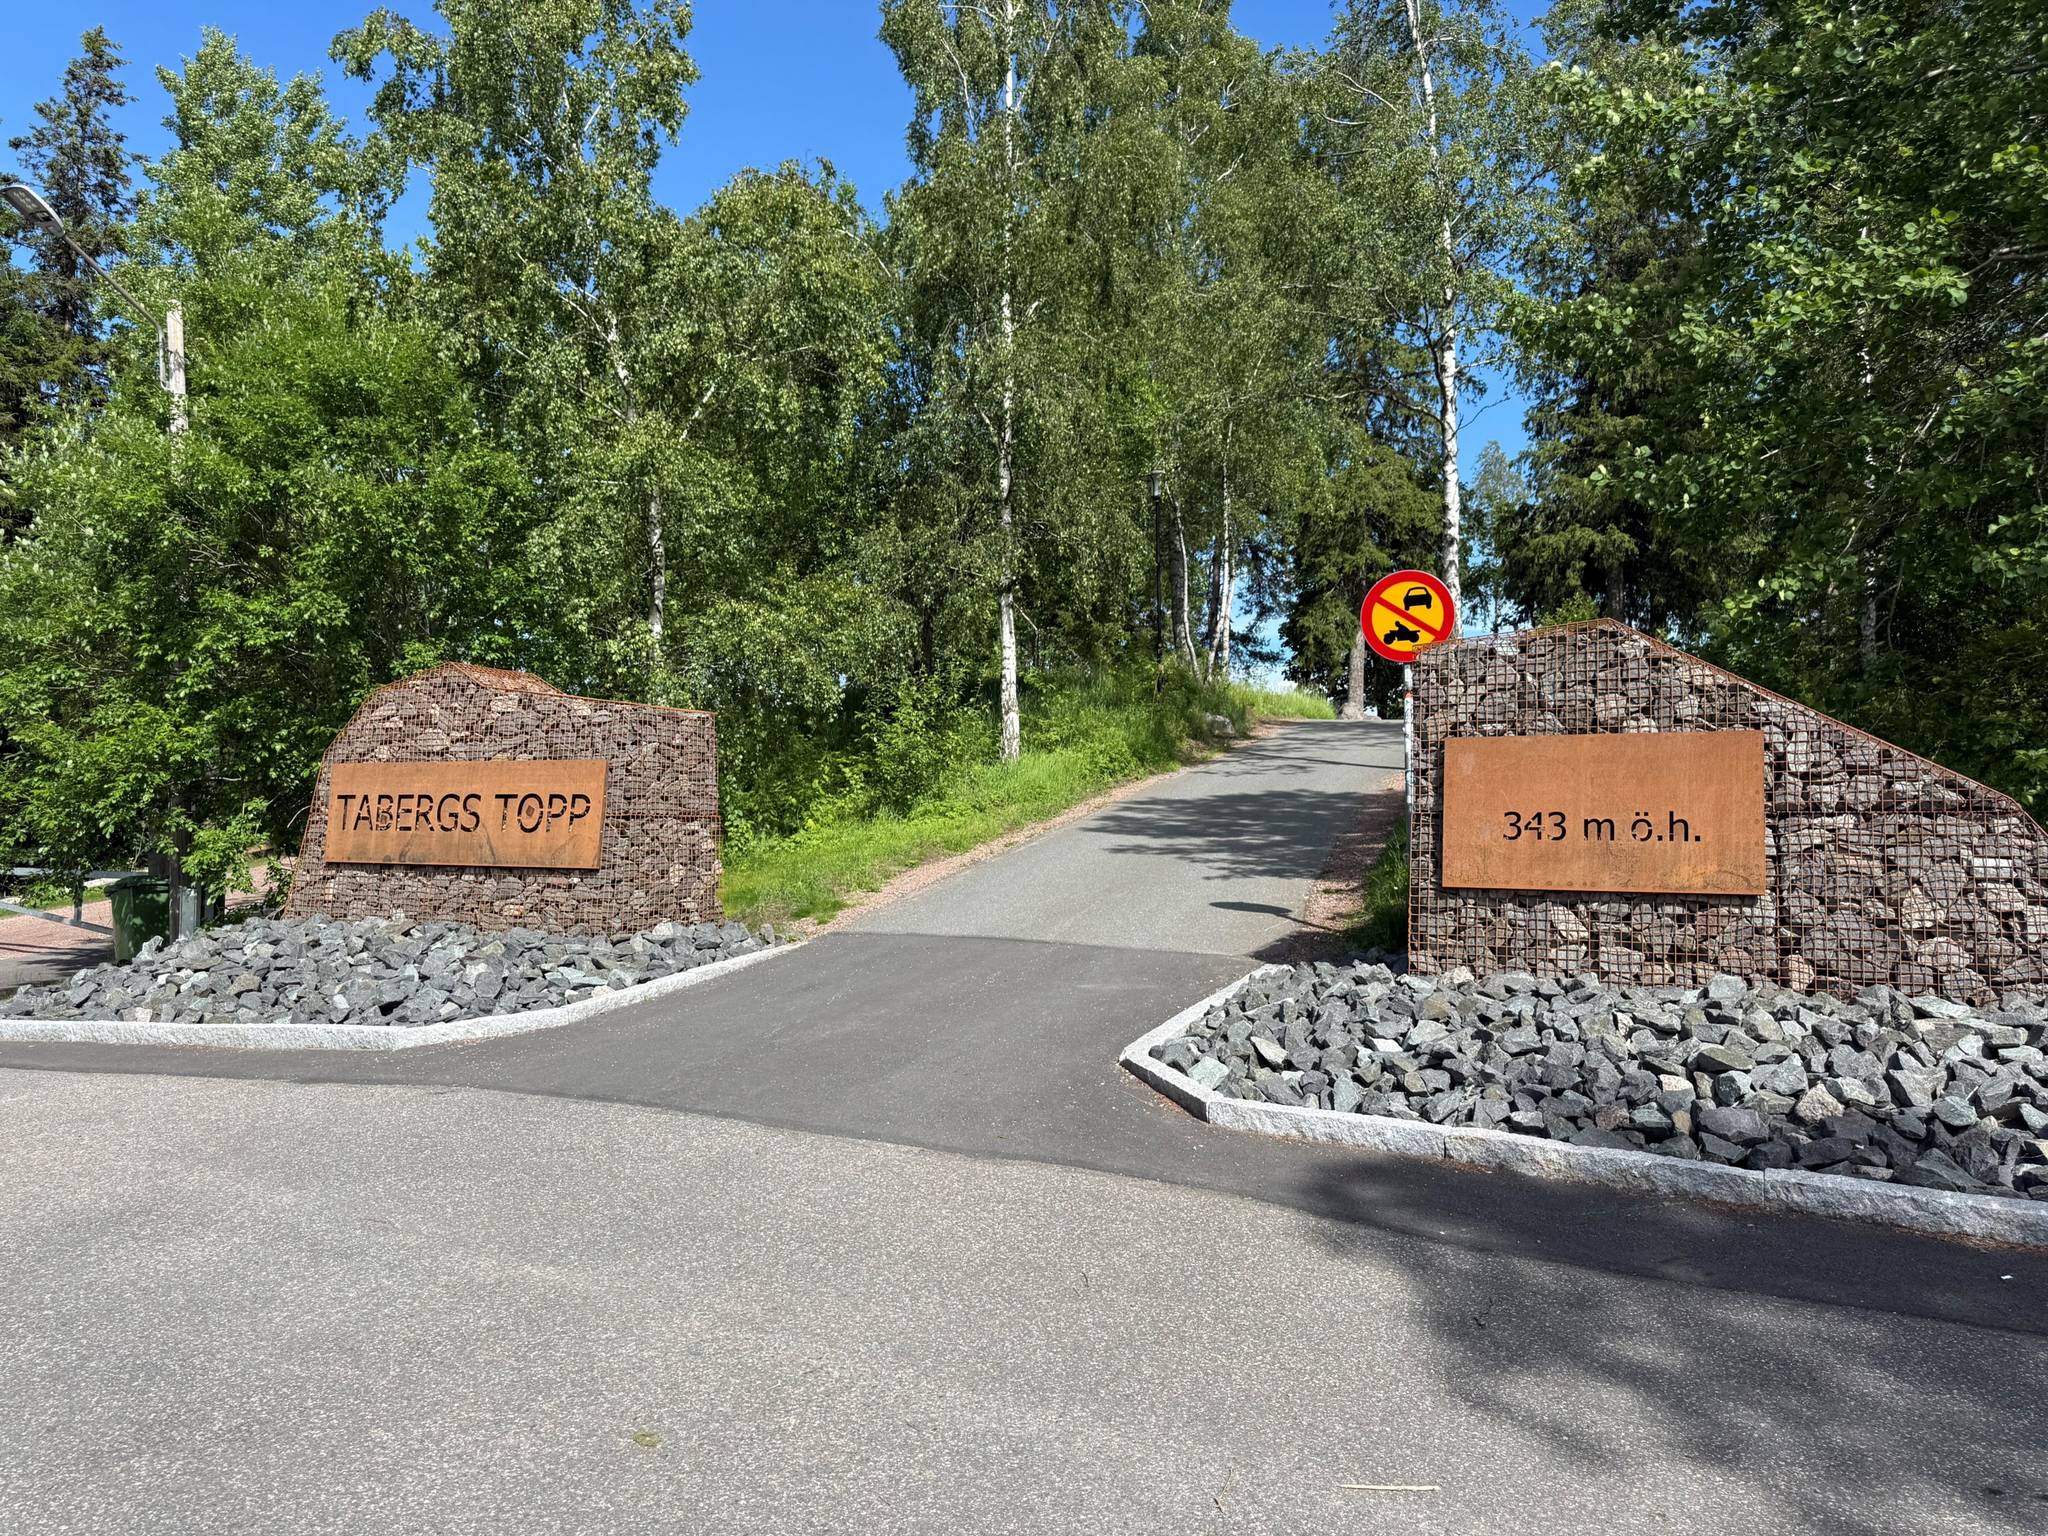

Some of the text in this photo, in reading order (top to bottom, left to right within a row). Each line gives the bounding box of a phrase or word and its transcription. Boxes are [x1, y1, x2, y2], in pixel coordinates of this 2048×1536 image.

[337, 793, 591, 833] TABERGS TOPP
[1503, 811, 1701, 842] 343 m ö.h.
